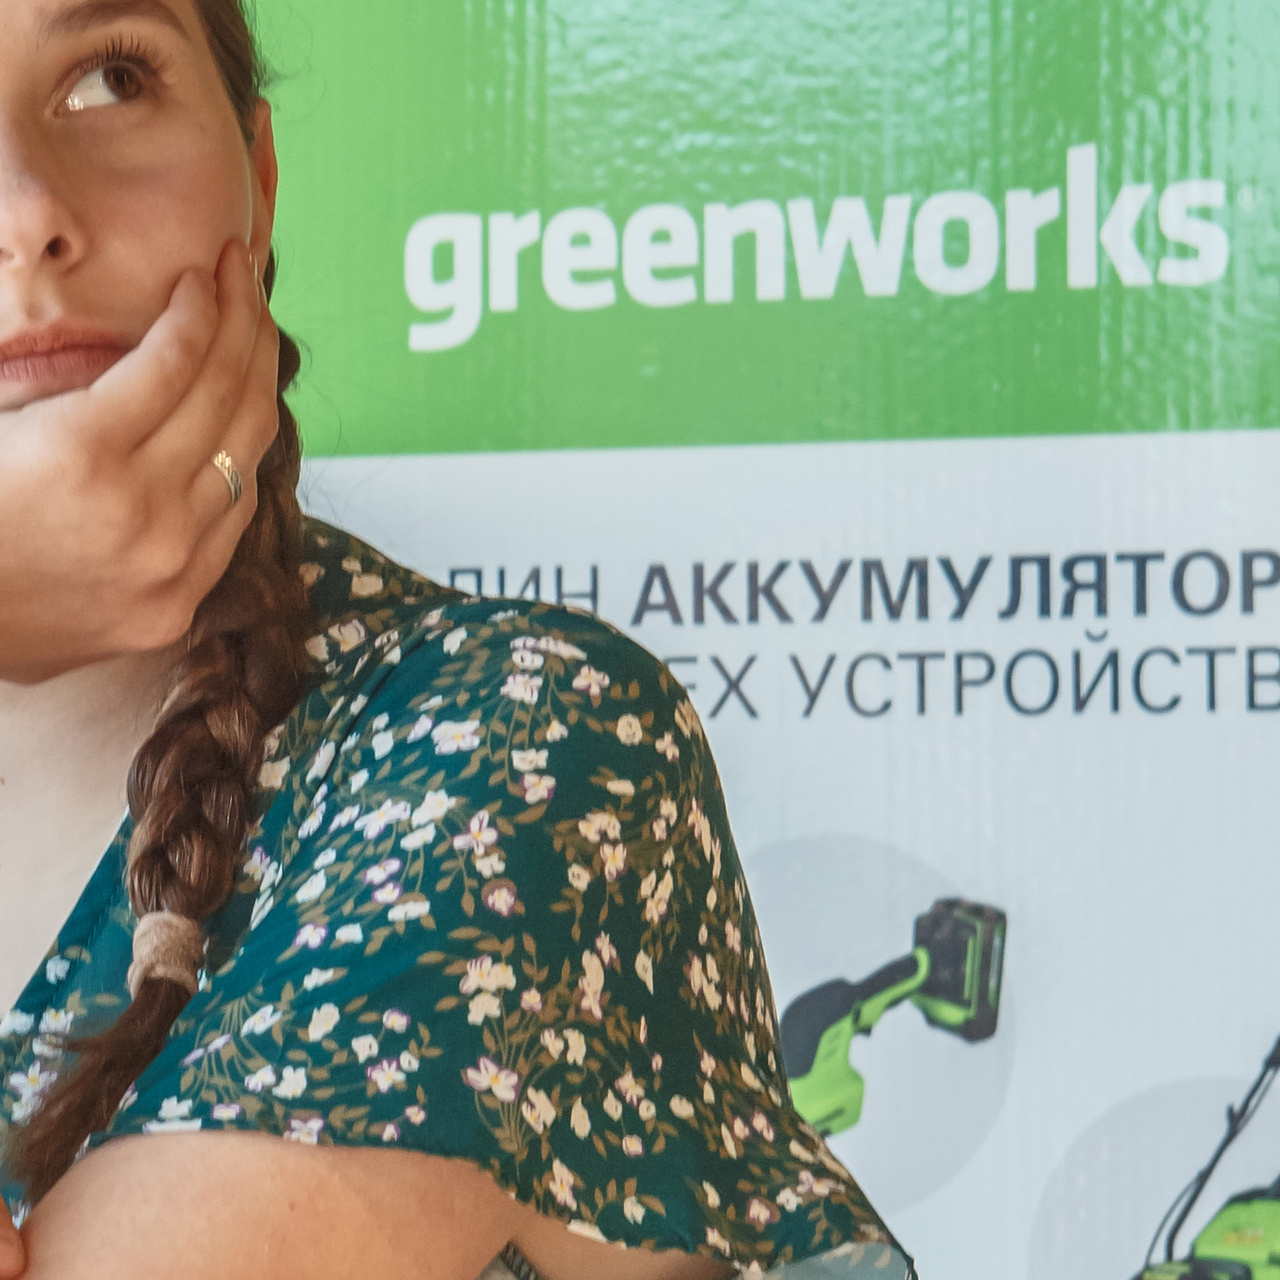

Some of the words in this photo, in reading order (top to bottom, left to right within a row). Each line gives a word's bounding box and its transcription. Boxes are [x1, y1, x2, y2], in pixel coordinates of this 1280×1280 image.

[404, 143, 1231, 352] greenworks
[630, 549, 1280, 627] АККУМУЛЯТОР
[788, 628, 1280, 720] УСТРОЙСТВ
